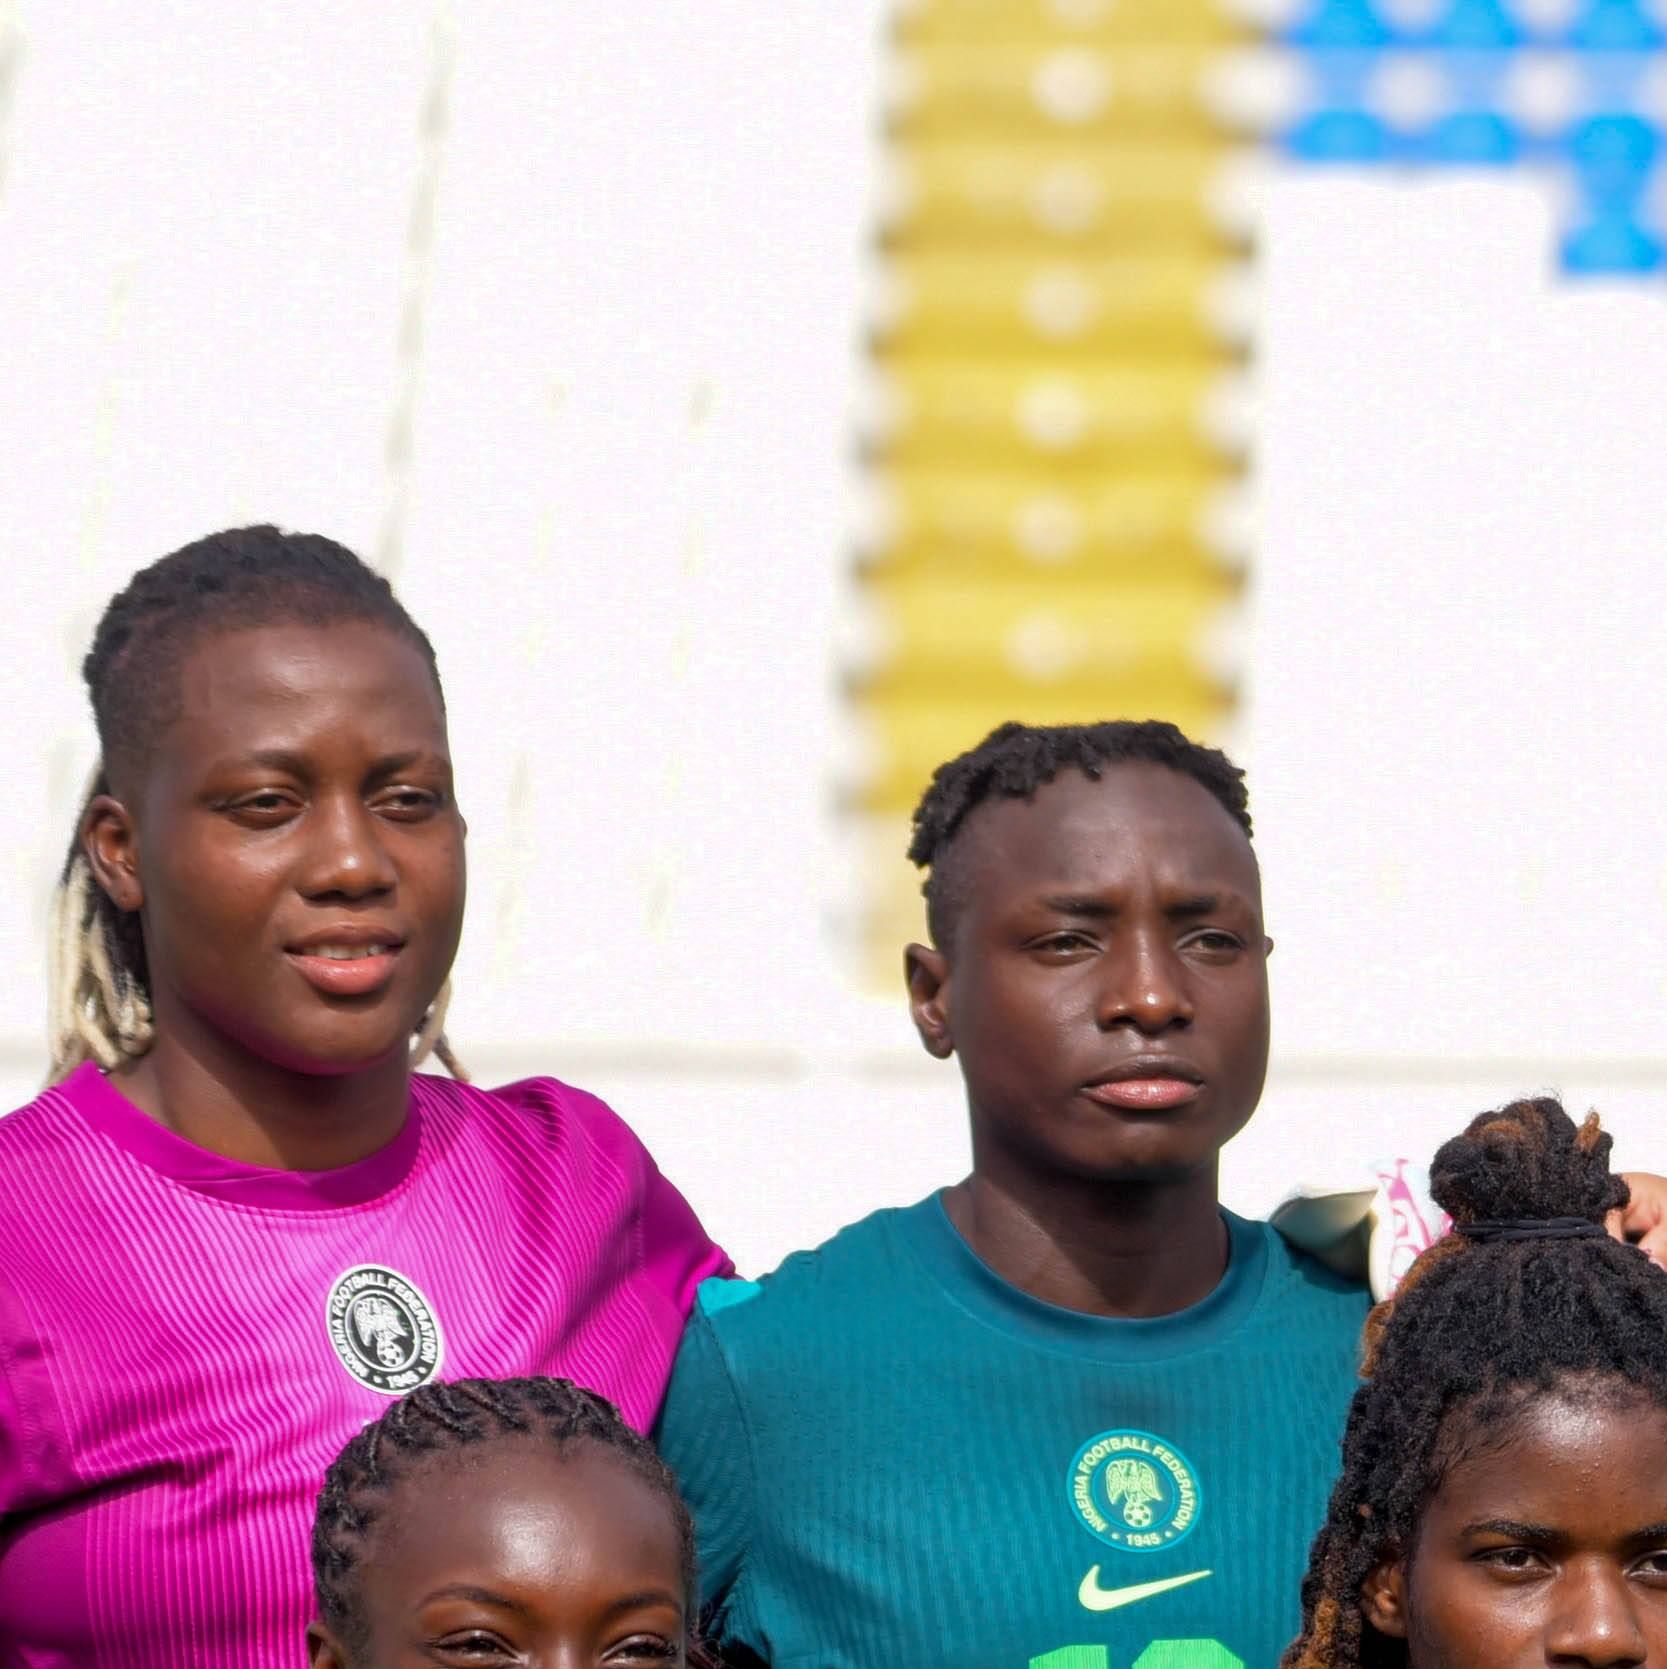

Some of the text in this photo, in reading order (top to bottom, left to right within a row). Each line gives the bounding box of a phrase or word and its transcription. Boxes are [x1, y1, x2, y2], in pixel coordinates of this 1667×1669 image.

[332, 1272, 437, 1378] NIGERIA FOOTBALL FEDERATION
[1074, 1436, 1194, 1532] NIGERIA FOOTBALL FEDERATION
[1126, 1533, 1161, 1546] 1945
